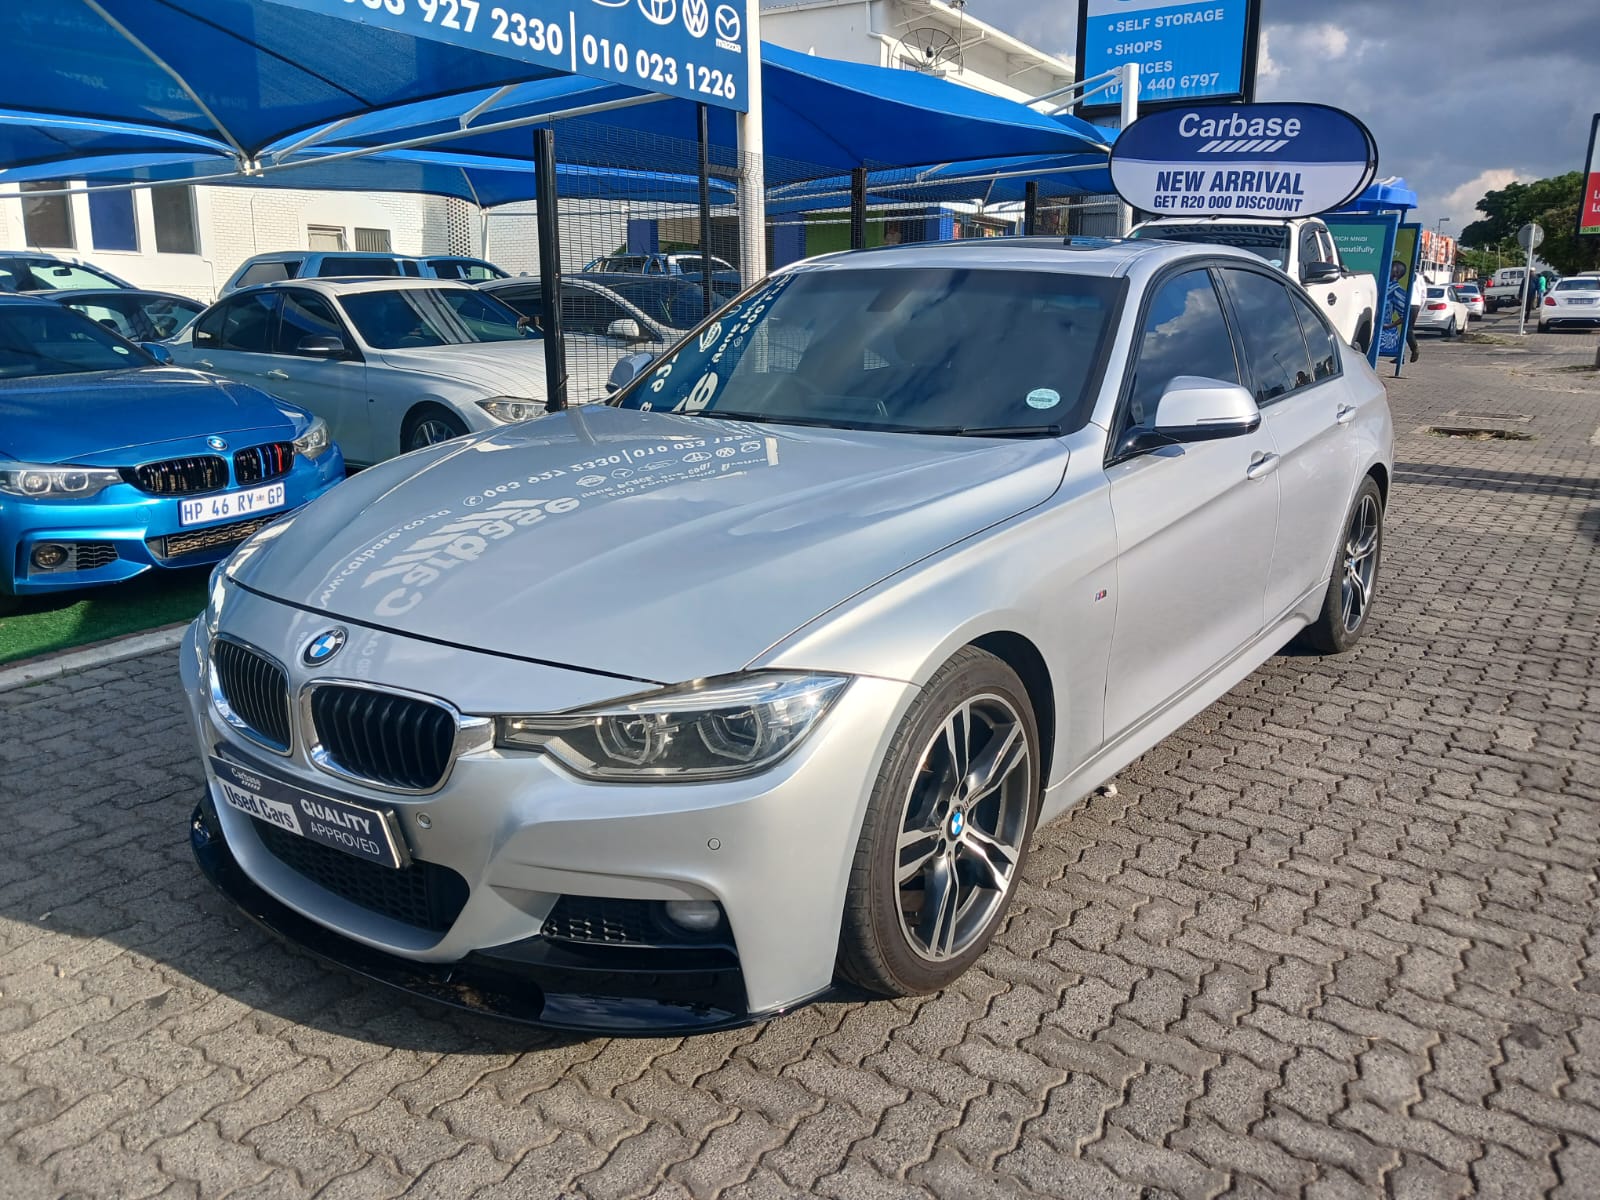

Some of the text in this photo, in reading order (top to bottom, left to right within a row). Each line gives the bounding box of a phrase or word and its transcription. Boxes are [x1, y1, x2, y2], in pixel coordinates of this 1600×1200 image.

[1116, 8, 1224, 33] SELF STORAGE
[417, 0, 480, 33] 927
[491, 7, 563, 56] 2330
[582, 34, 628, 73] 010
[636, 49, 678, 86] 023
[685, 63, 736, 100] 1226
[1114, 40, 1163, 56] SHOPS
[1147, 77, 1176, 92] 440
[1180, 72, 1220, 89] 6797
[1179, 112, 1301, 138] Carbase
[1156, 171, 1304, 195] NEW ARRIVAL
[1154, 195, 1303, 212] GET R20 000 DISCOUNT
[184, 486, 283, 521] HP 46 RY GP
[224, 784, 294, 829] Used Cars
[300, 799, 370, 835] QUALITY
[311, 822, 380, 856] APPROVED
